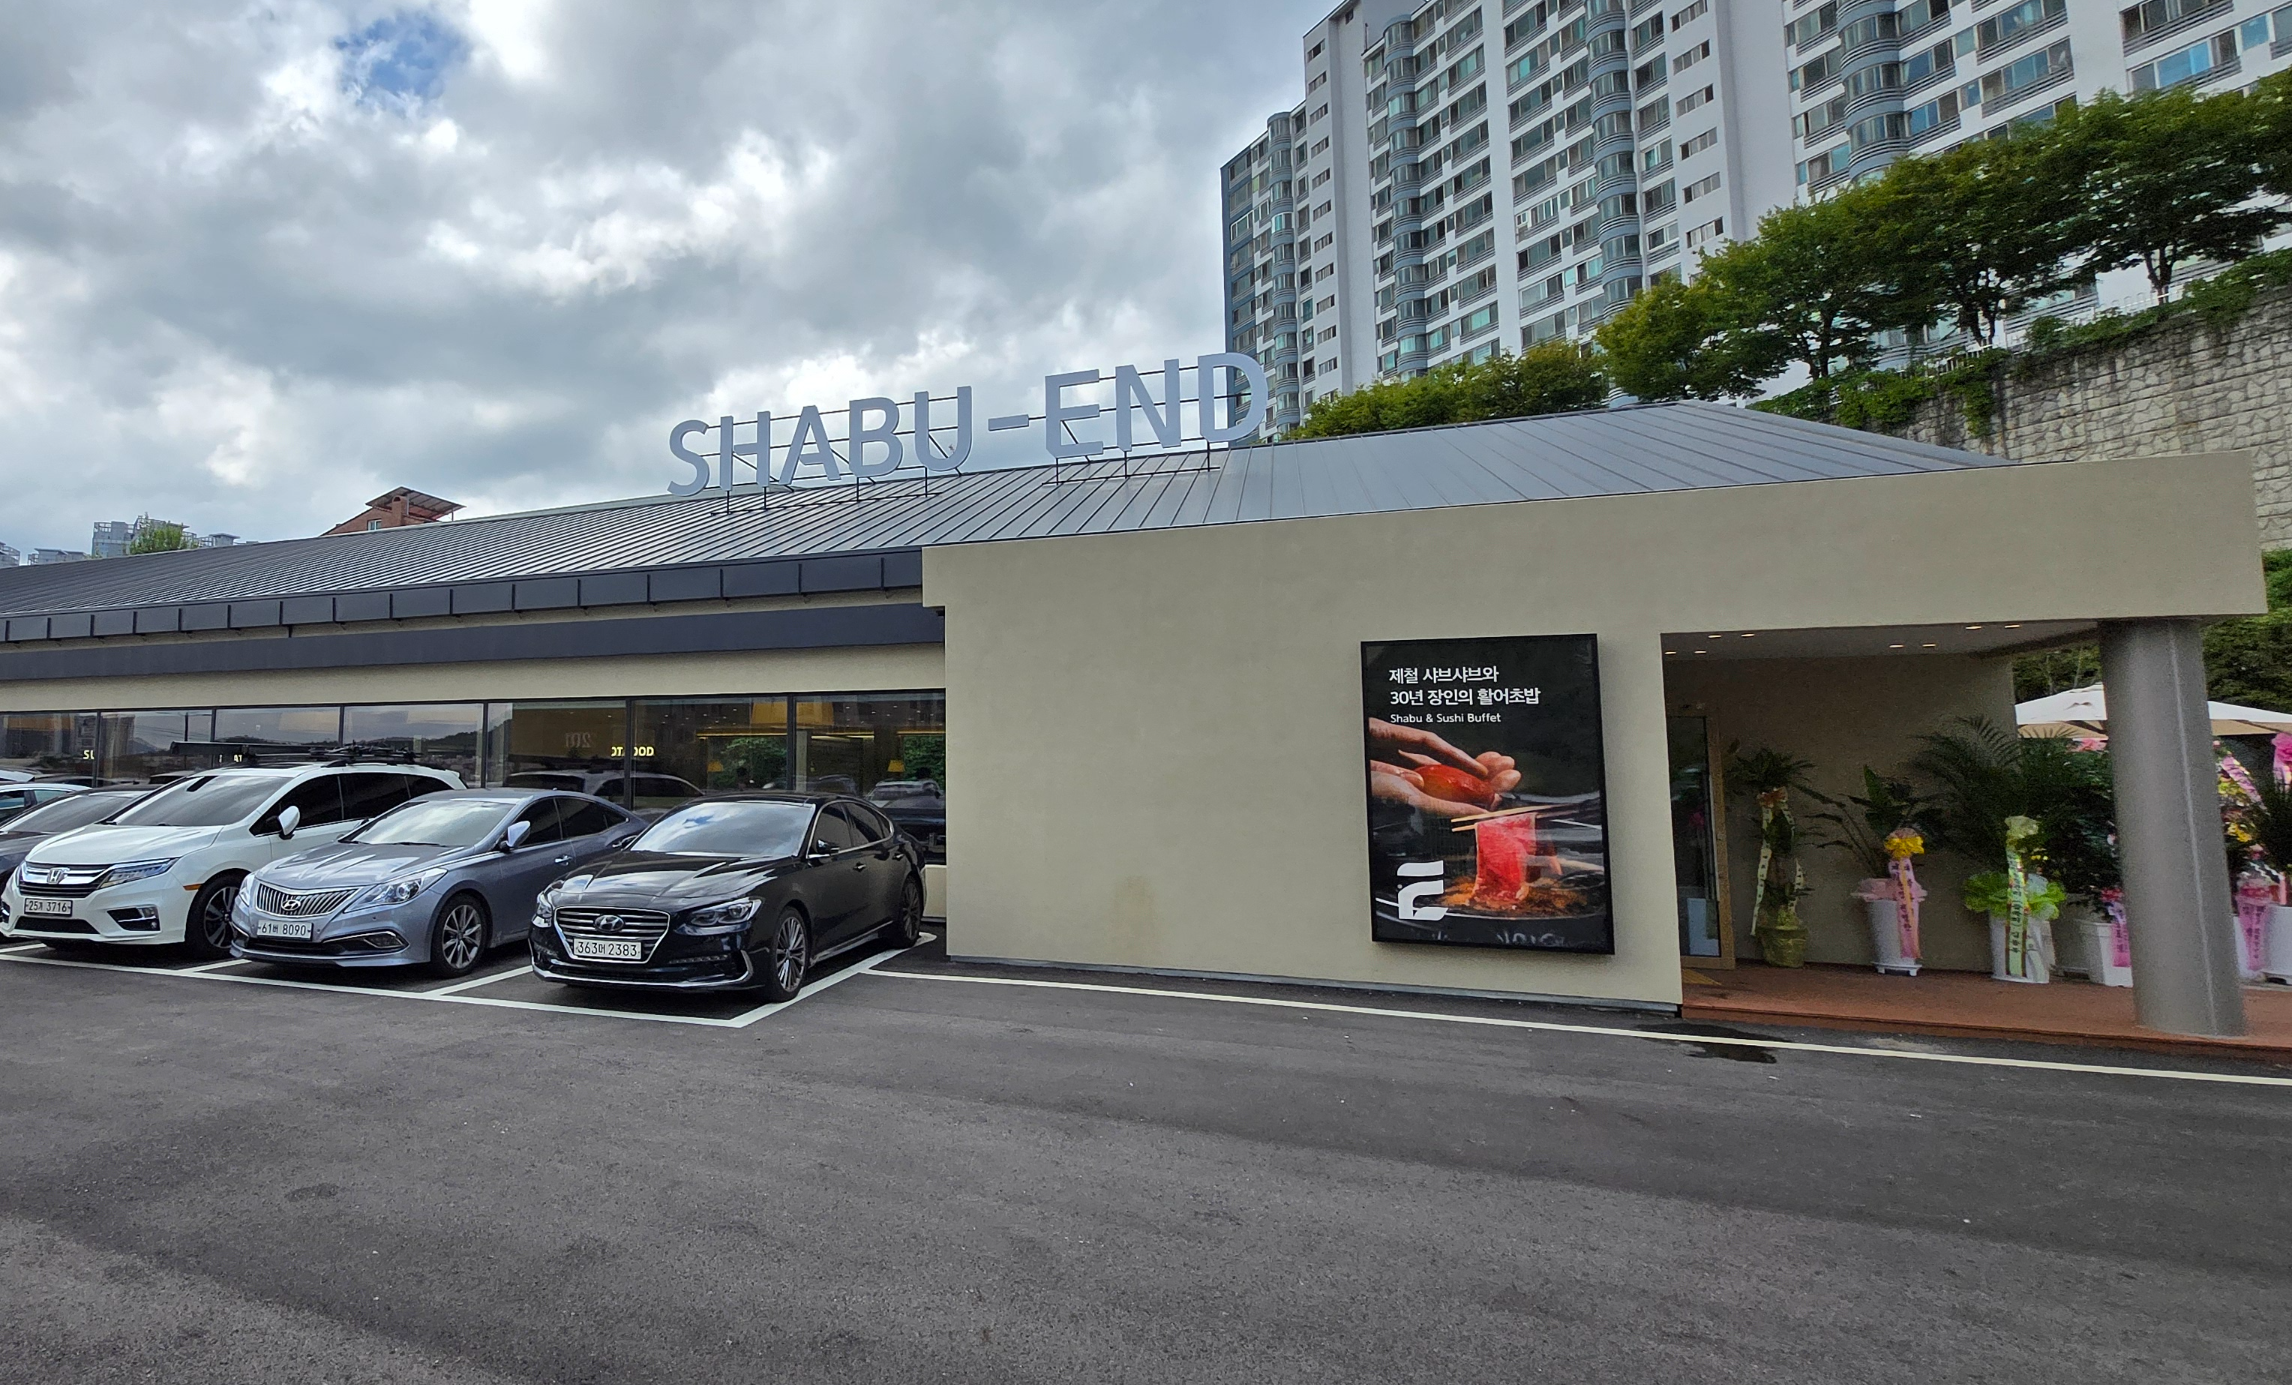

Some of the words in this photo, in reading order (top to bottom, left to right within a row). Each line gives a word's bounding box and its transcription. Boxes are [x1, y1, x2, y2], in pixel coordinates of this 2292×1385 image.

[667, 352, 1269, 497] SHABU-END
[1389, 667, 1419, 684] 제철
[1423, 665, 1499, 684] 샤브샤브와
[1390, 689, 1424, 706] 30년
[1427, 688, 1473, 706] 장인의
[1477, 687, 1541, 706] 활어초밥
[1390, 713, 1423, 723] Shabu
[1425, 714, 1434, 723] &
[1436, 713, 1464, 723] Sushi
[1467, 712, 1502, 723] Buffet
[46, 902, 67, 912] 3716
[282, 923, 307, 936] 8090
[608, 943, 637, 957] 2383
